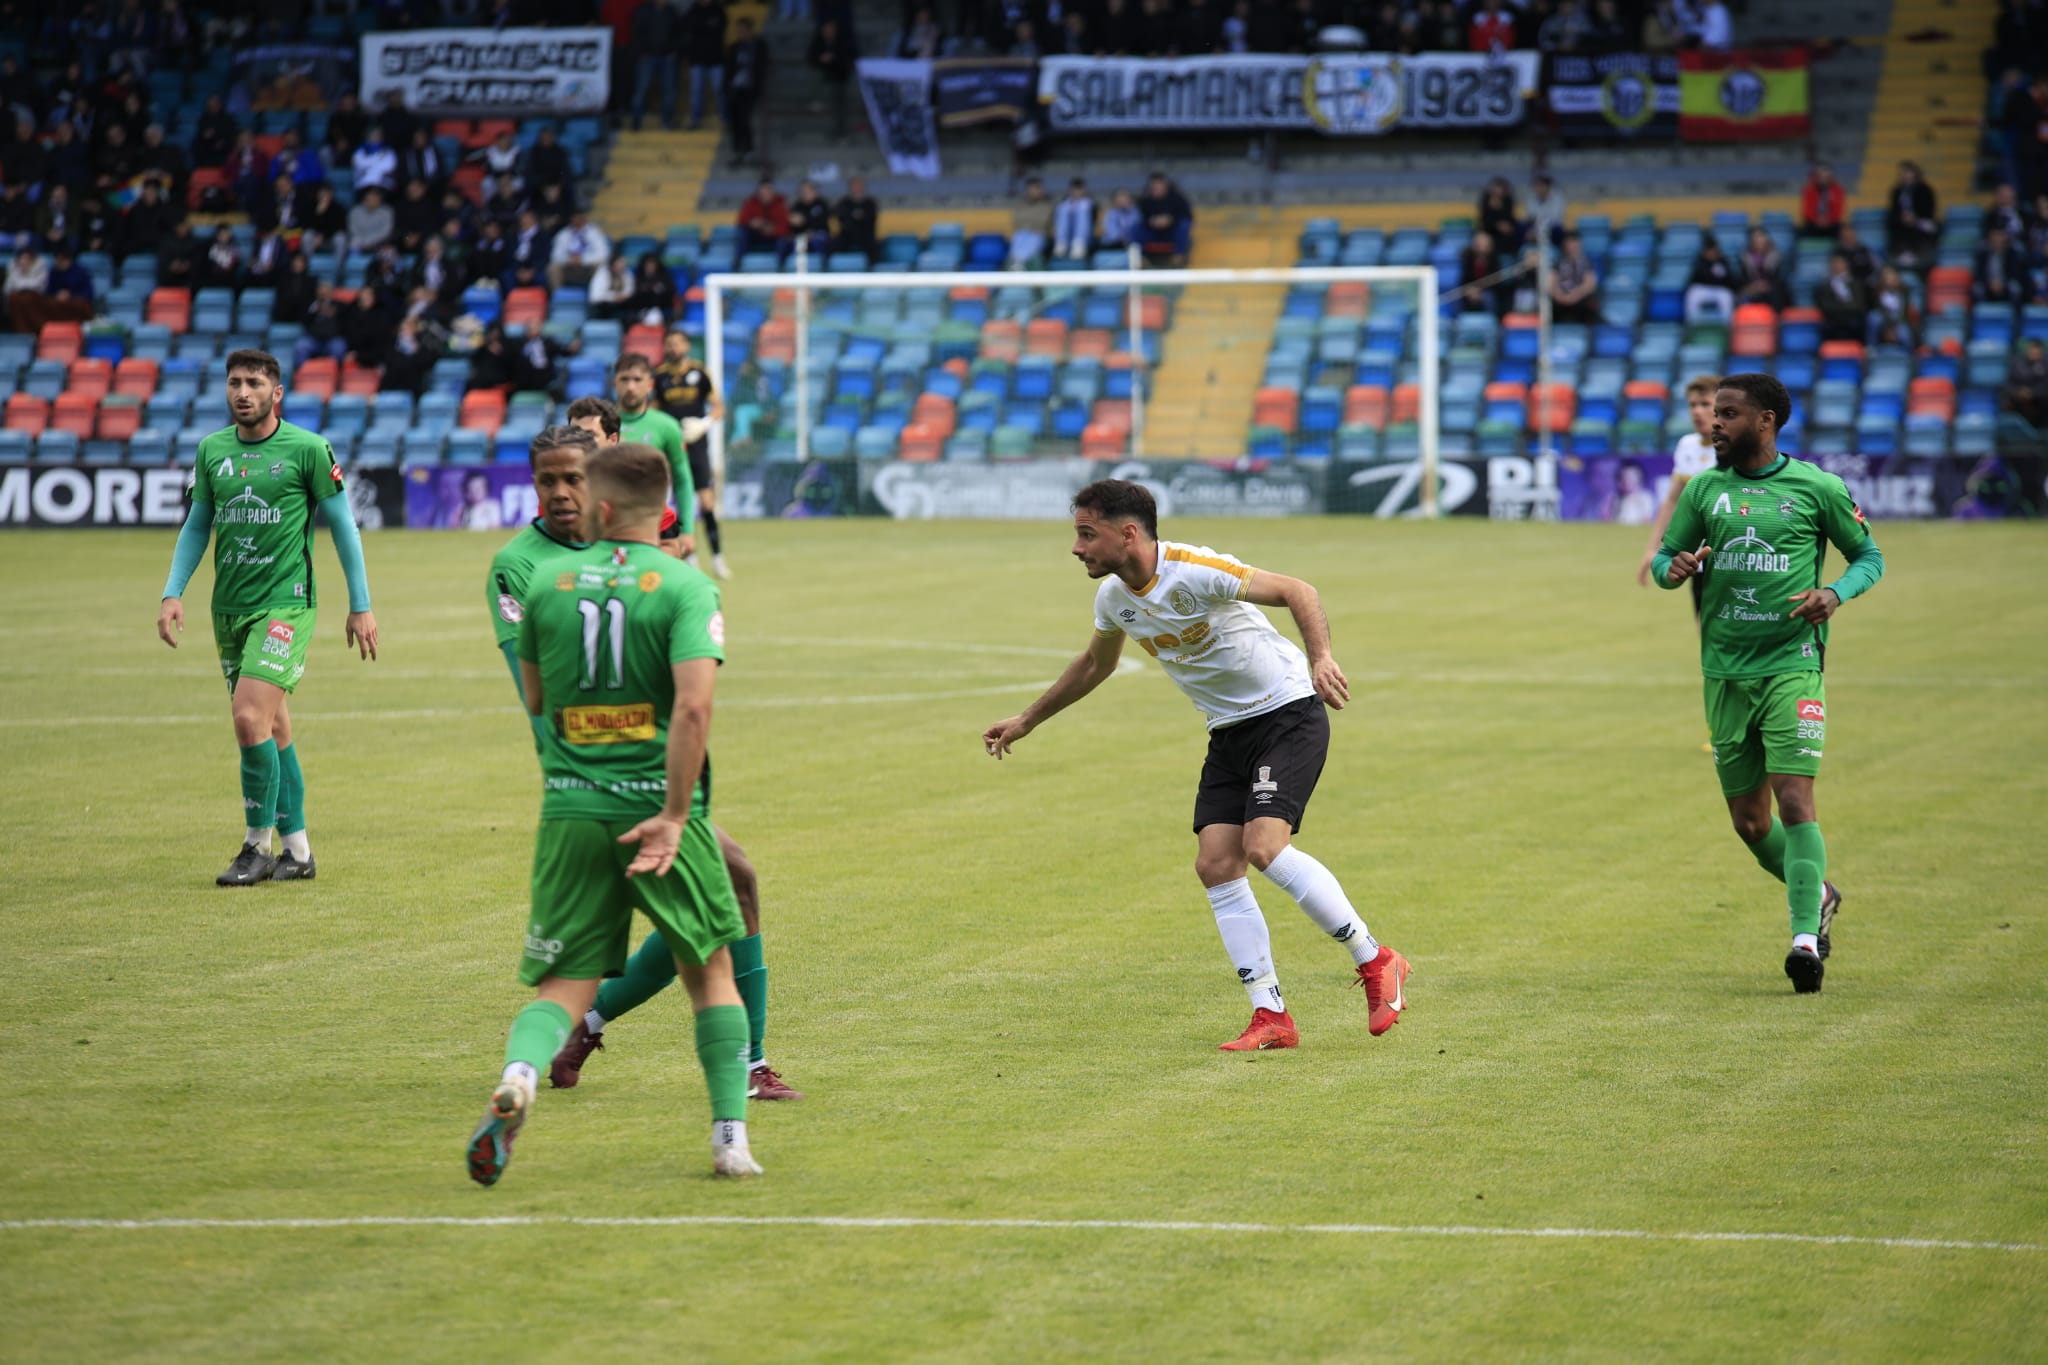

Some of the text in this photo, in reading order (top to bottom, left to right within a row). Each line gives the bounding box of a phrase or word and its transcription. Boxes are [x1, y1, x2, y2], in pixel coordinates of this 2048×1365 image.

[1057, 67, 1304, 119] SALAMANCA
[1405, 66, 1518, 118] 1923
[1746, 553, 1790, 572] PABLO
[578, 598, 625, 690] 11
